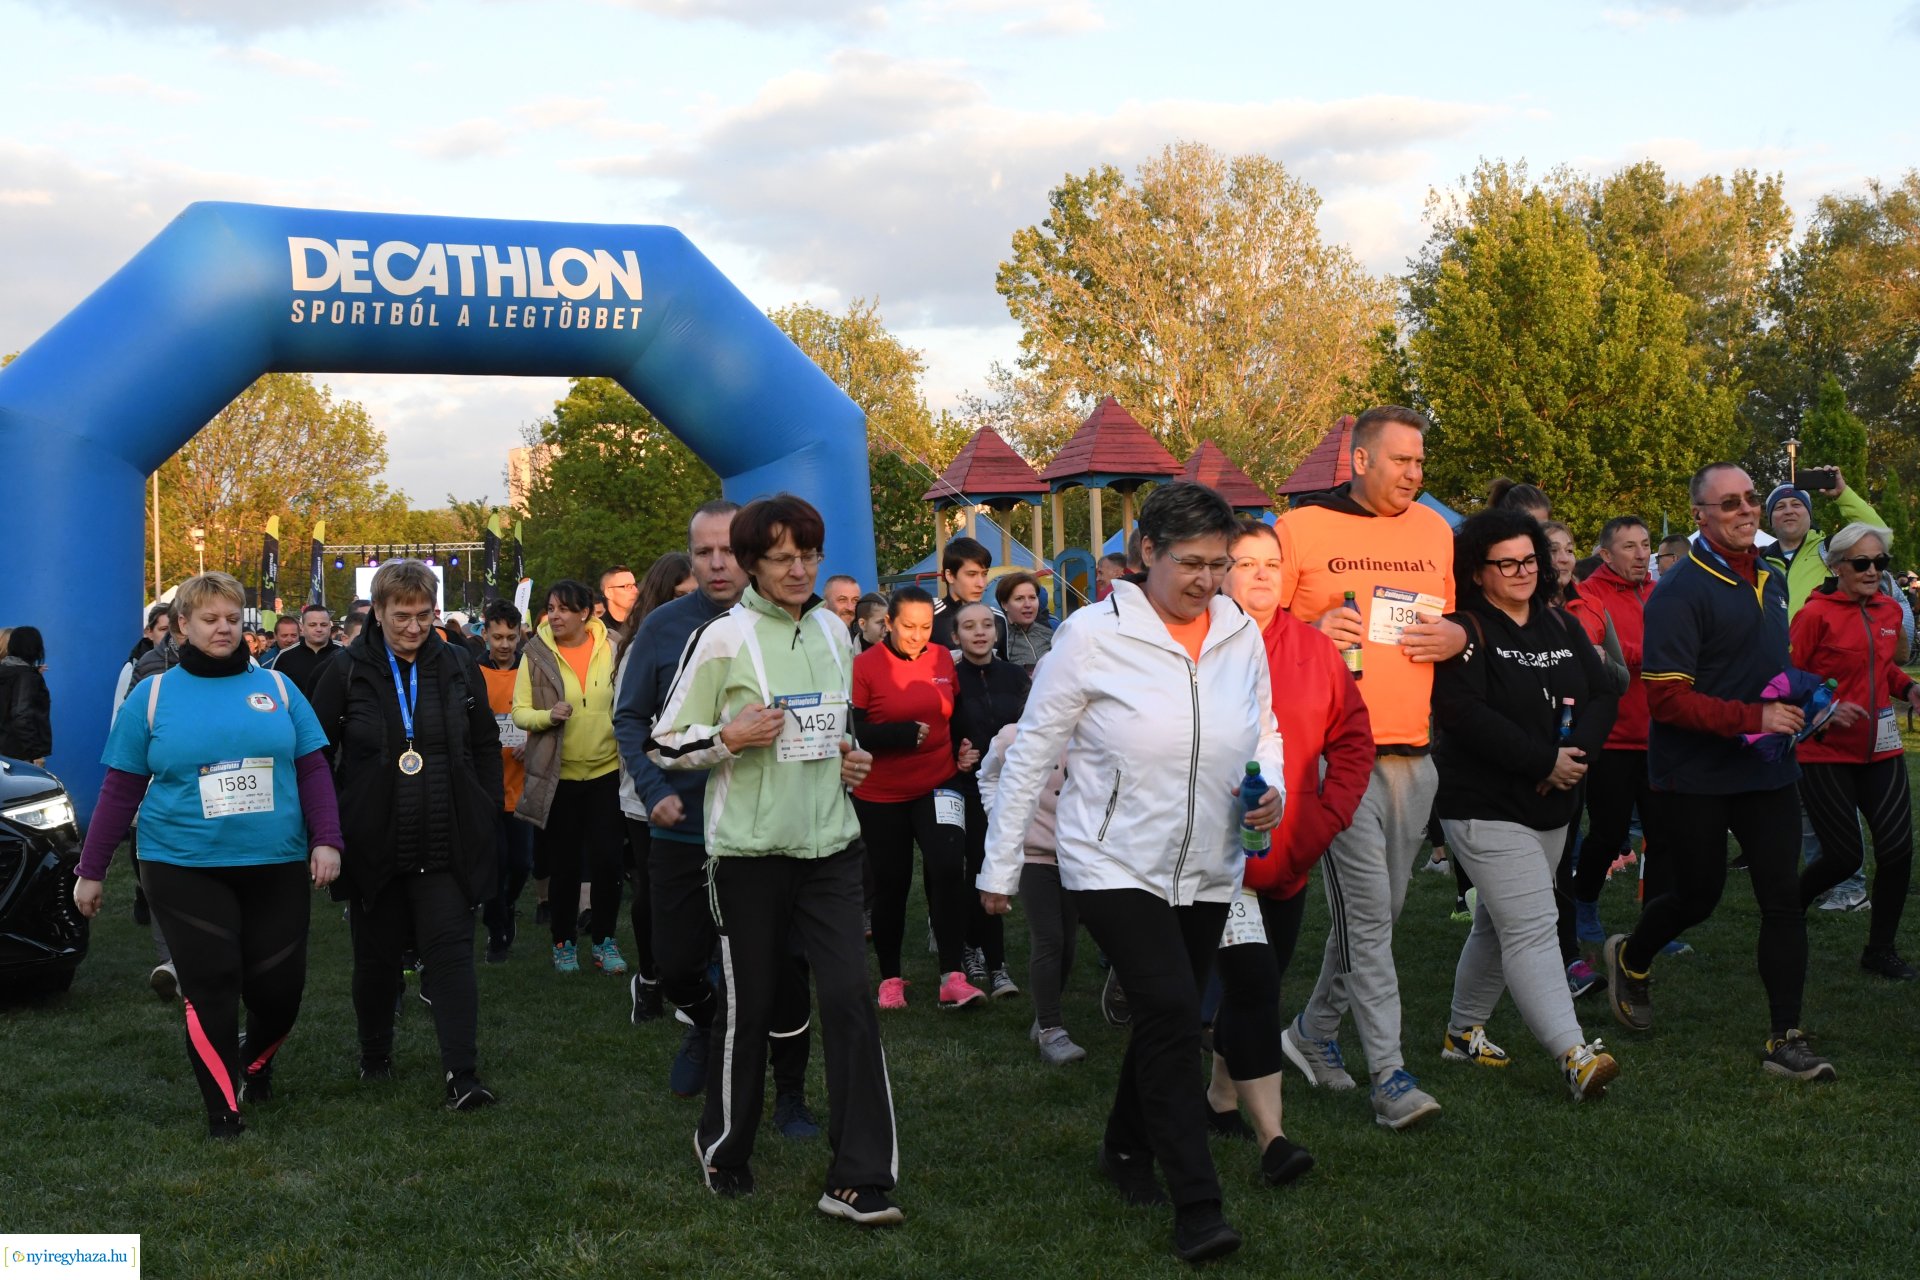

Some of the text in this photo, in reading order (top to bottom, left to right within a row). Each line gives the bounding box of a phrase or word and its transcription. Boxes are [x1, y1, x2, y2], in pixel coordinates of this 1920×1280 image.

[287, 236, 643, 300] DECATHLON
[291, 297, 643, 330] SPORTBÓL A LEGTÖBBET
[1328, 557, 1425, 574] Continental
[797, 712, 836, 733] 1452
[217, 774, 257, 793] 1583
